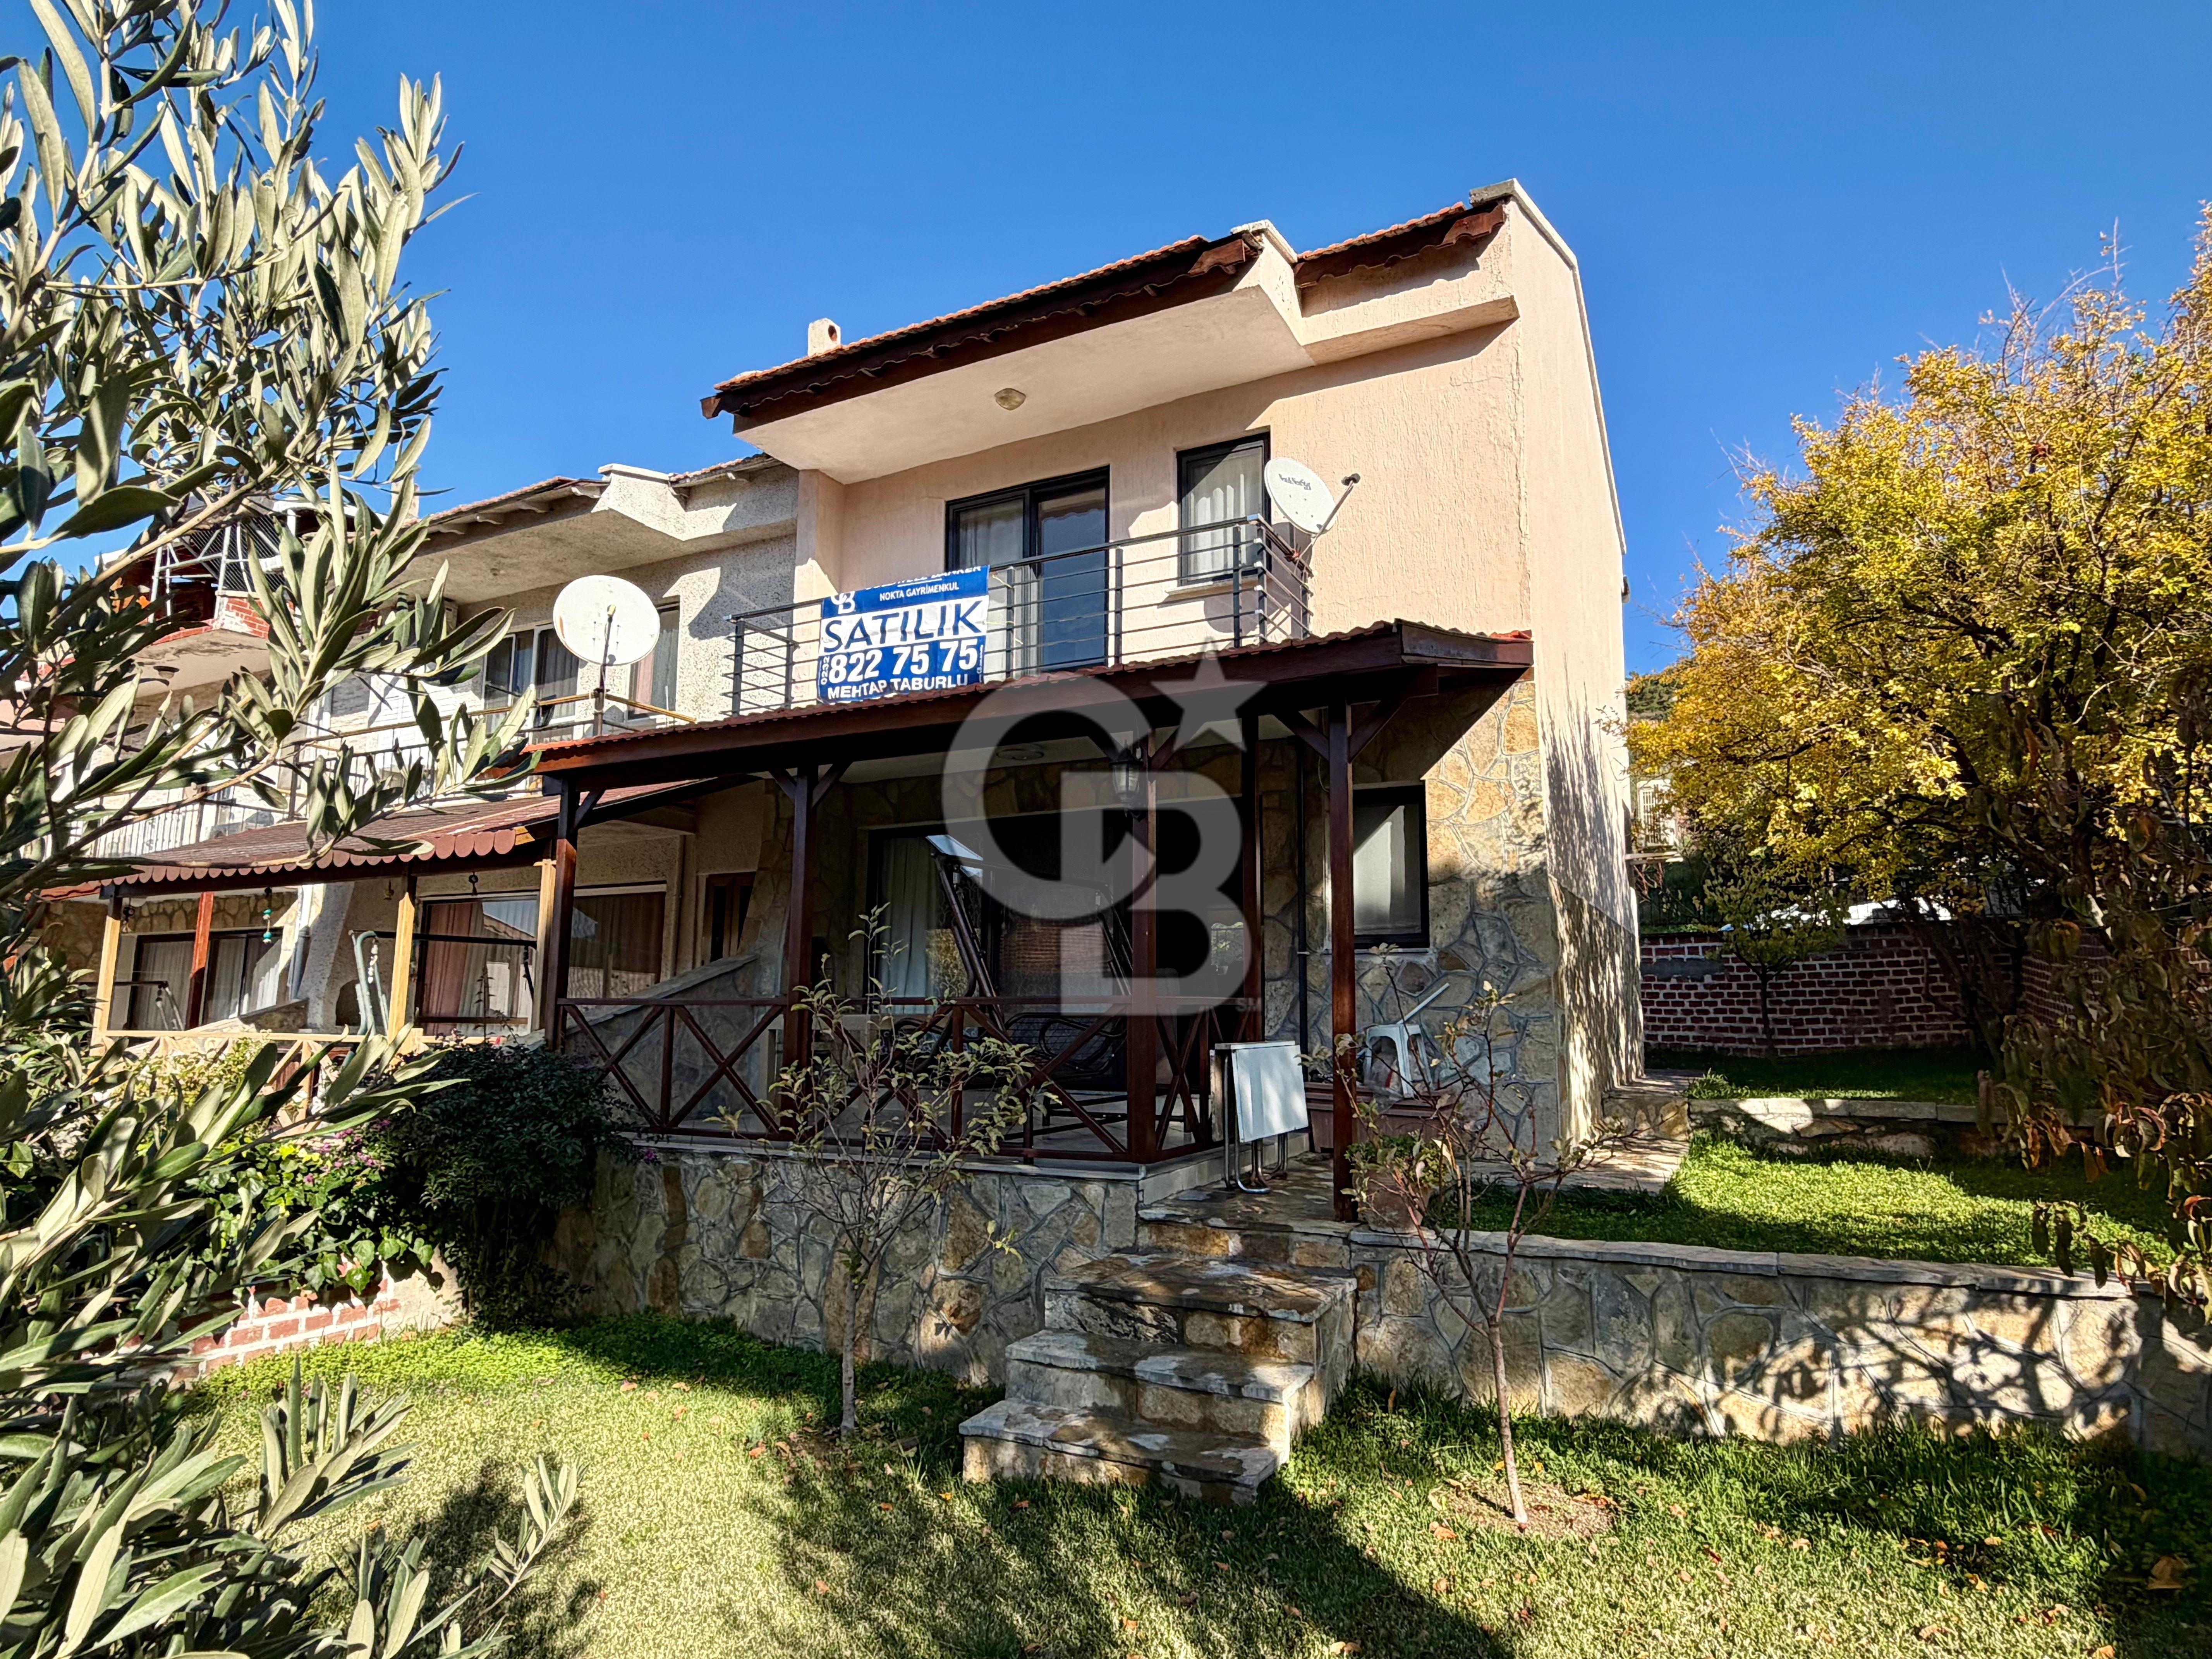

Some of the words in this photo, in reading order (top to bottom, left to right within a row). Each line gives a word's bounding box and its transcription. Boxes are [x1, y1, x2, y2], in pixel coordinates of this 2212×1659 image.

[879, 590, 905, 601] NOKTA
[906, 582, 960, 597] GAYRİMENKUL
[823, 600, 983, 653] SATILIK
[820, 656, 830, 685] 0232
[829, 649, 883, 684] 822
[893, 644, 929, 675] 75
[939, 638, 978, 672] 75
[828, 679, 887, 699] MEHTAP
[891, 673, 968, 692] TABURLU
